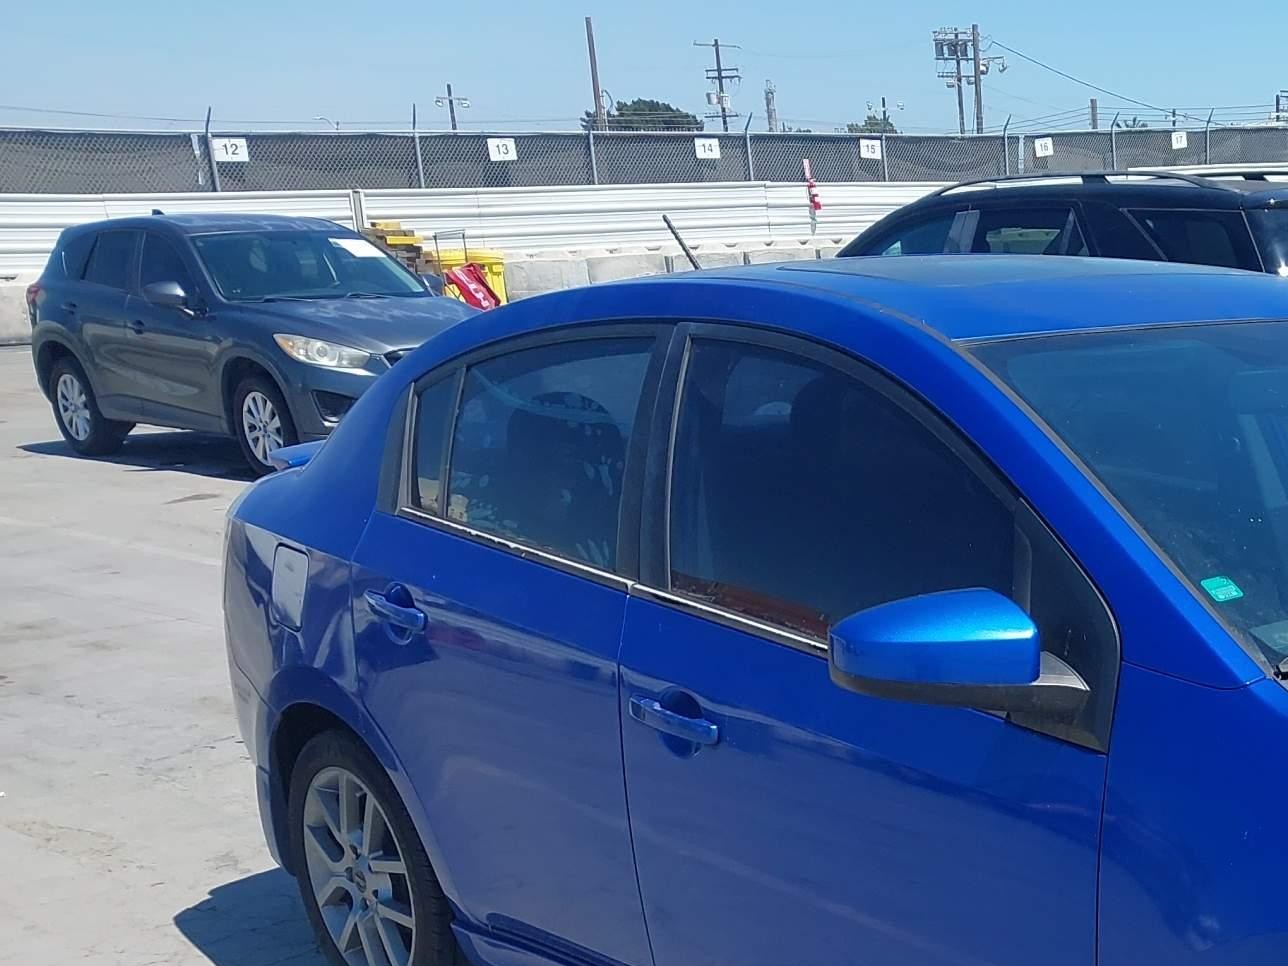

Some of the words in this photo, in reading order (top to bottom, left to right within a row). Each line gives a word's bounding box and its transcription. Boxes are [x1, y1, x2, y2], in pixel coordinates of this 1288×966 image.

[222, 143, 240, 156] 12
[495, 143, 510, 155] 13
[701, 143, 714, 153] 14
[866, 144, 876, 154] 15
[1039, 142, 1049, 153] 16
